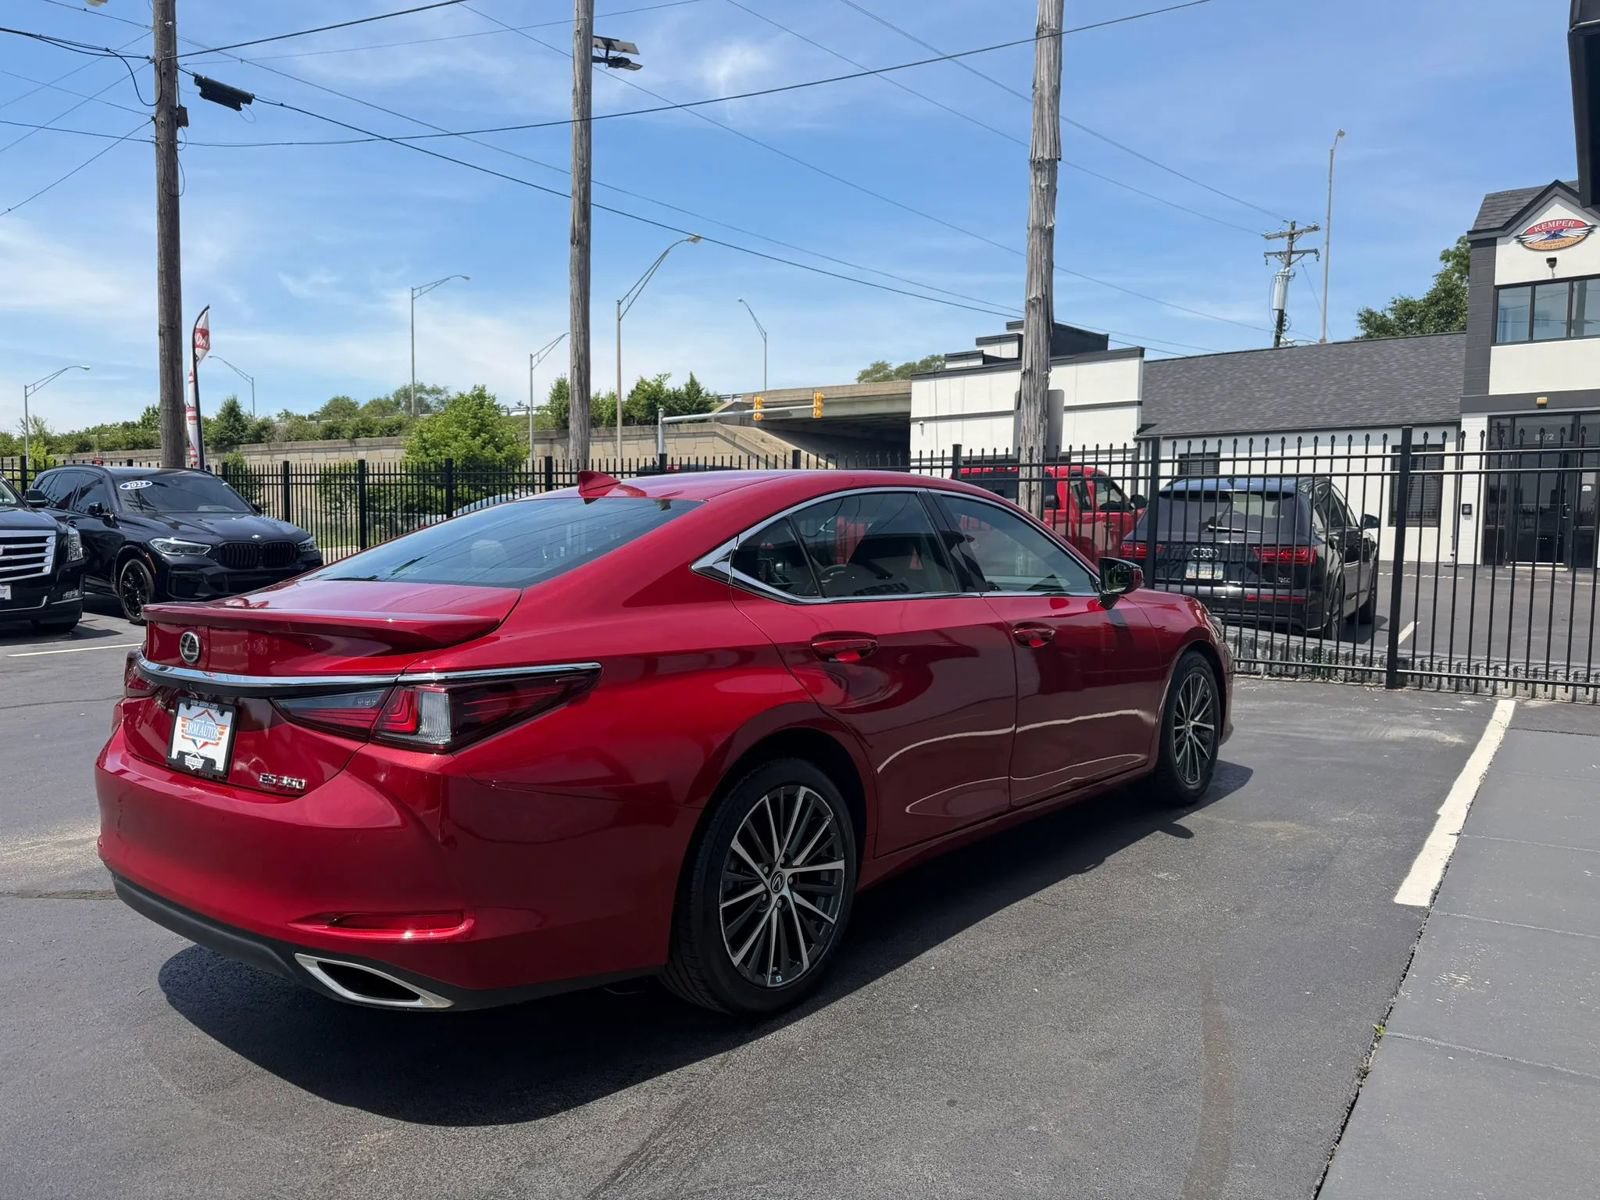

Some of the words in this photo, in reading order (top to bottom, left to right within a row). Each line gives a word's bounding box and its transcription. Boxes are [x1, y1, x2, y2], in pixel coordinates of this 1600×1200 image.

[1534, 220, 1575, 232] KEMPER
[1535, 433, 1553, 441] 872
[259, 772, 276, 784] ES
[278, 775, 305, 789] 350
